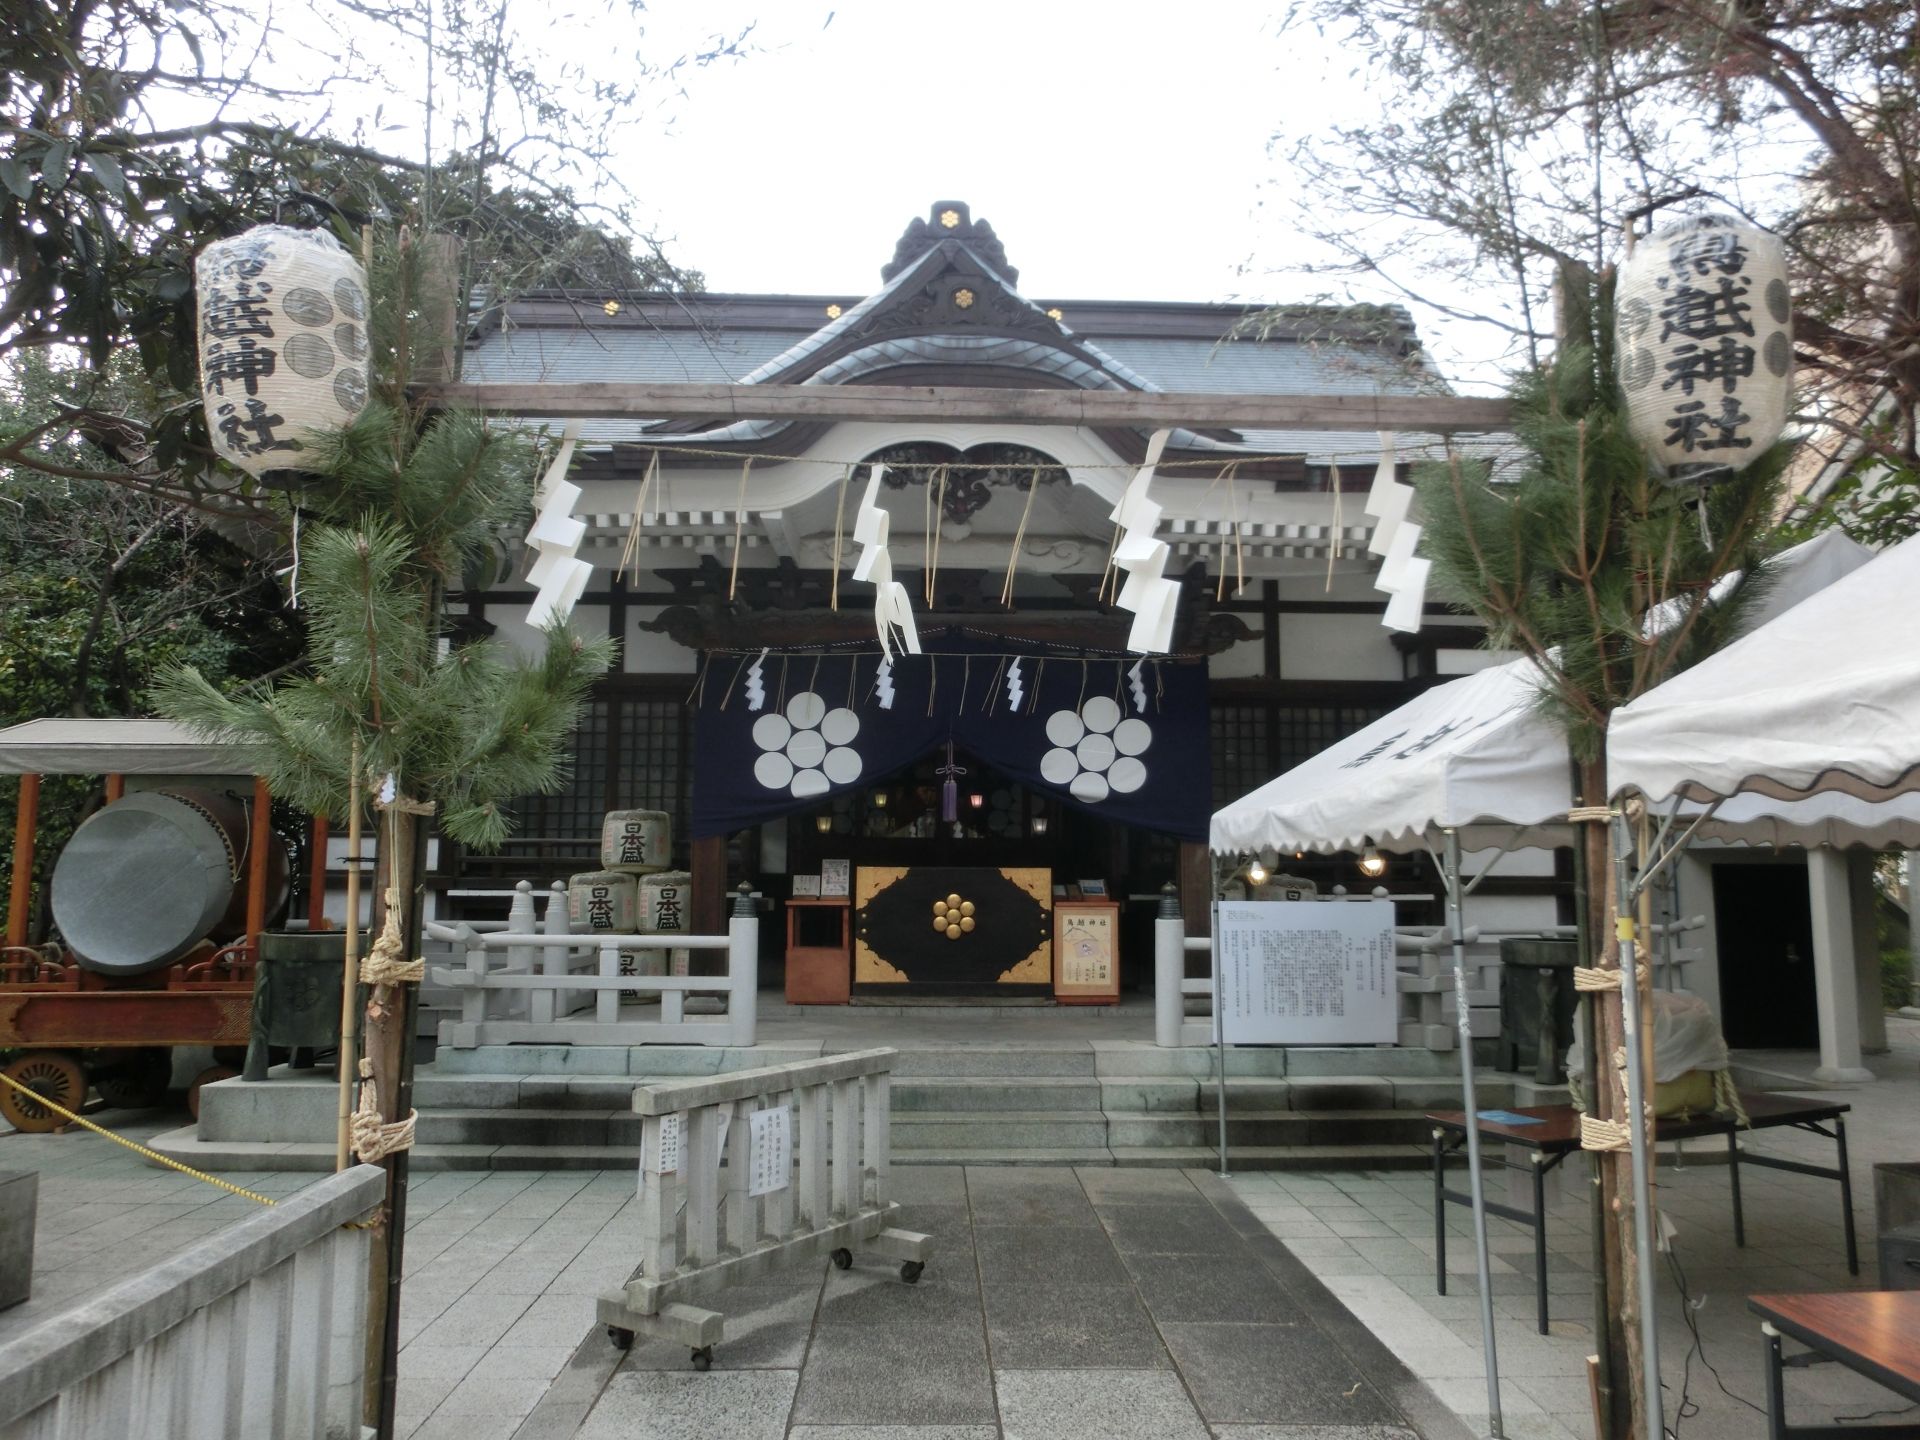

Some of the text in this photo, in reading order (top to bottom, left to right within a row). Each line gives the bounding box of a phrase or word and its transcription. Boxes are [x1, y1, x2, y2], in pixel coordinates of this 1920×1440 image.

[1656, 230, 1756, 454] 鳥越神社
[620, 822, 646, 864] 日本盛
[588, 887, 614, 929] 日本盛
[655, 888, 682, 930] 日本盛
